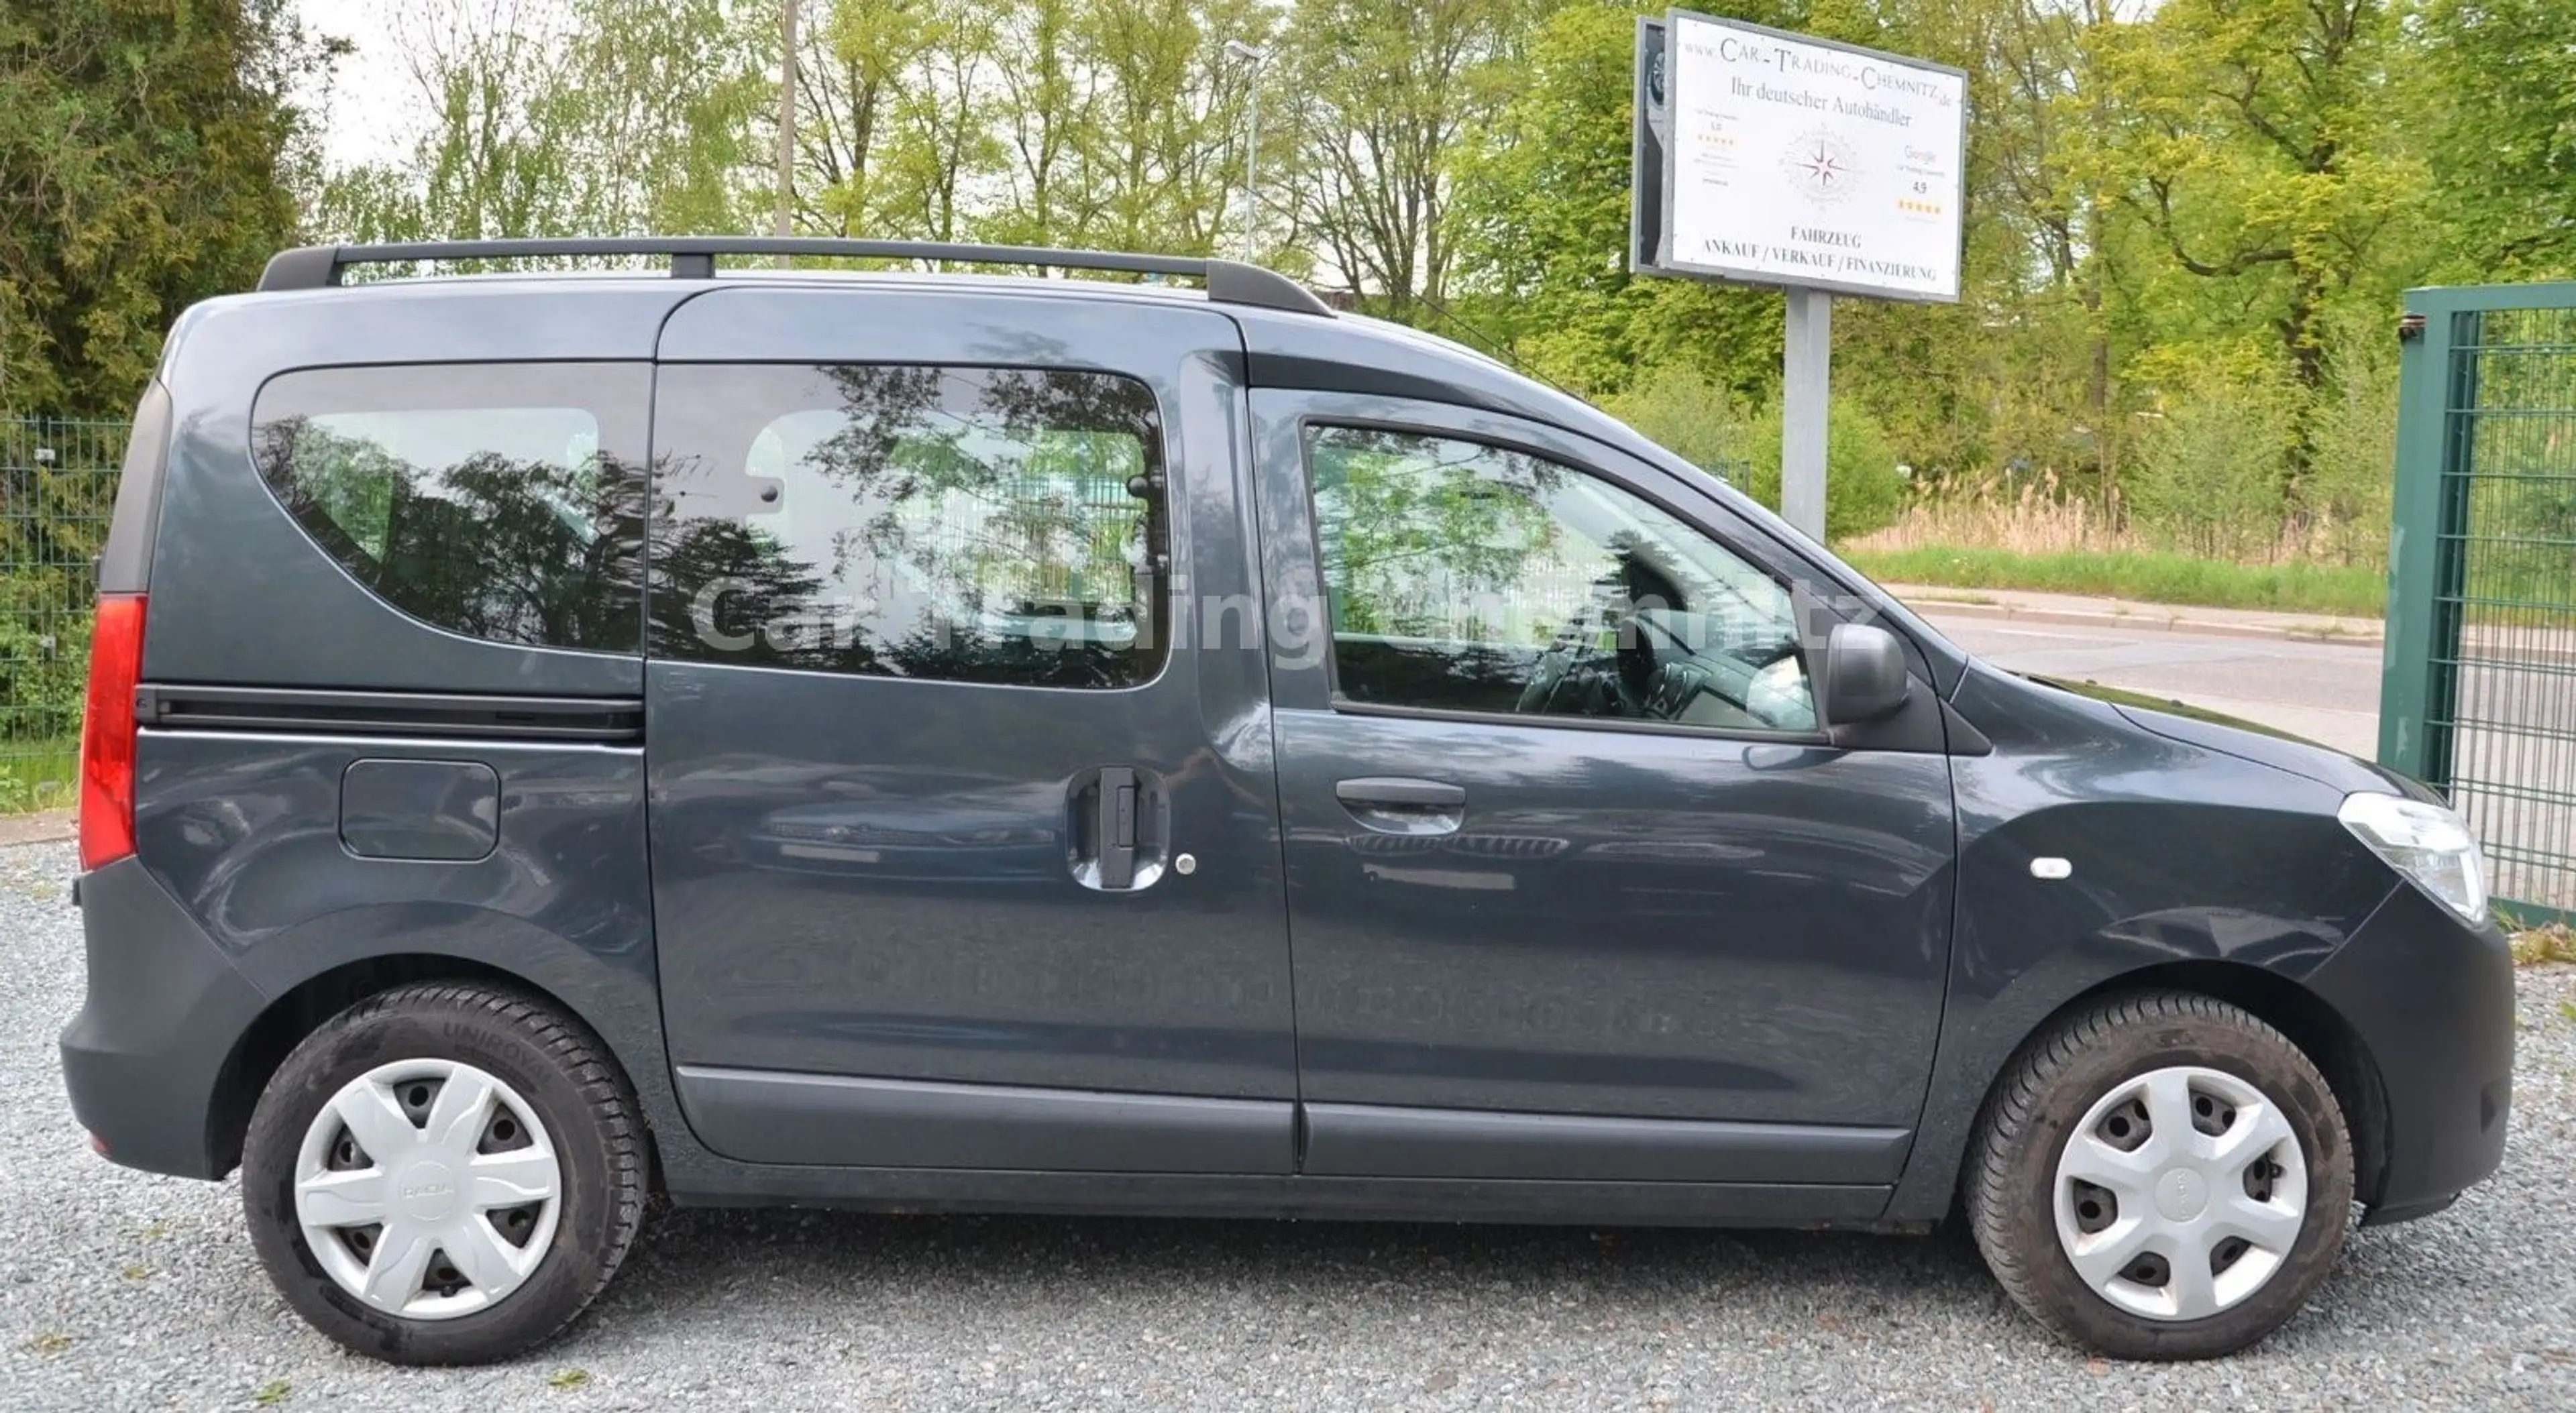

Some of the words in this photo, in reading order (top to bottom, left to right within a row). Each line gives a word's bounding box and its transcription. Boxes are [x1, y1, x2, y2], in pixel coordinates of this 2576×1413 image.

[1731, 76, 1751, 97] Ihr
[1756, 82, 1830, 112] deutscher
[1832, 97, 1912, 128] Autohändler
[1790, 225, 1862, 249] FAHRZEUG
[1704, 239, 1760, 260] ANKAUF
[1772, 247, 1838, 269] VERKAUF
[1846, 256, 1937, 281] FINANZIERUNG
